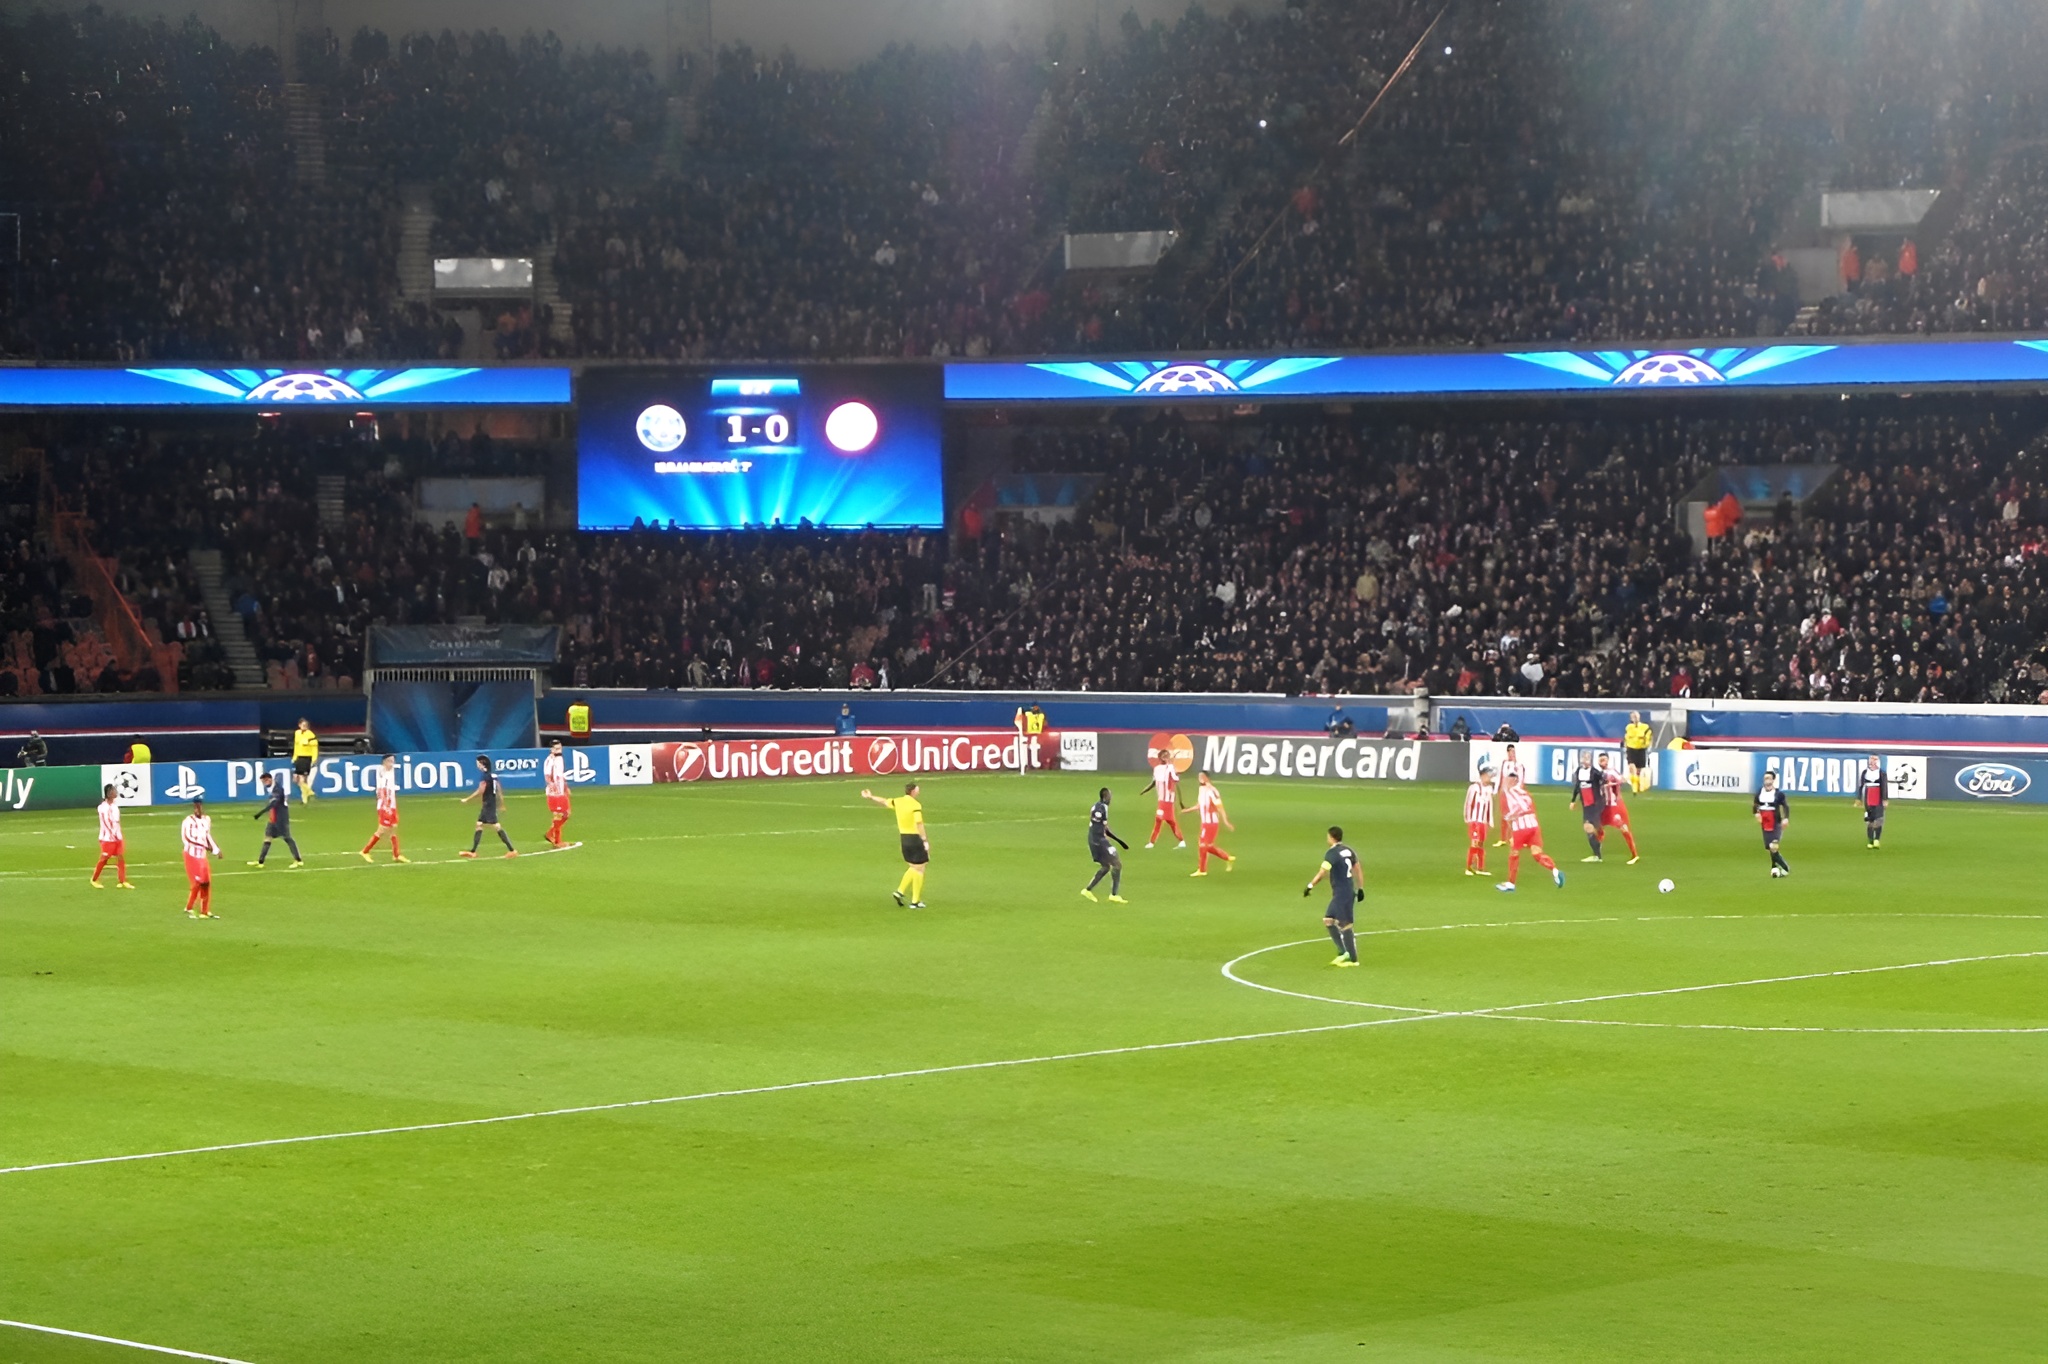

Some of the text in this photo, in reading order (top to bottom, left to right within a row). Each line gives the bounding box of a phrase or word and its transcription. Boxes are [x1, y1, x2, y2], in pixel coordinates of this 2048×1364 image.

[728, 414, 789, 443] 1-0
[495, 758, 539, 771] SONY
[708, 741, 853, 778] UniCredit
[902, 736, 1041, 772] UniCredit
[1203, 735, 1422, 780] MasterCard
[227, 755, 464, 798] PlaStaion
[1969, 767, 2016, 792] Ford
